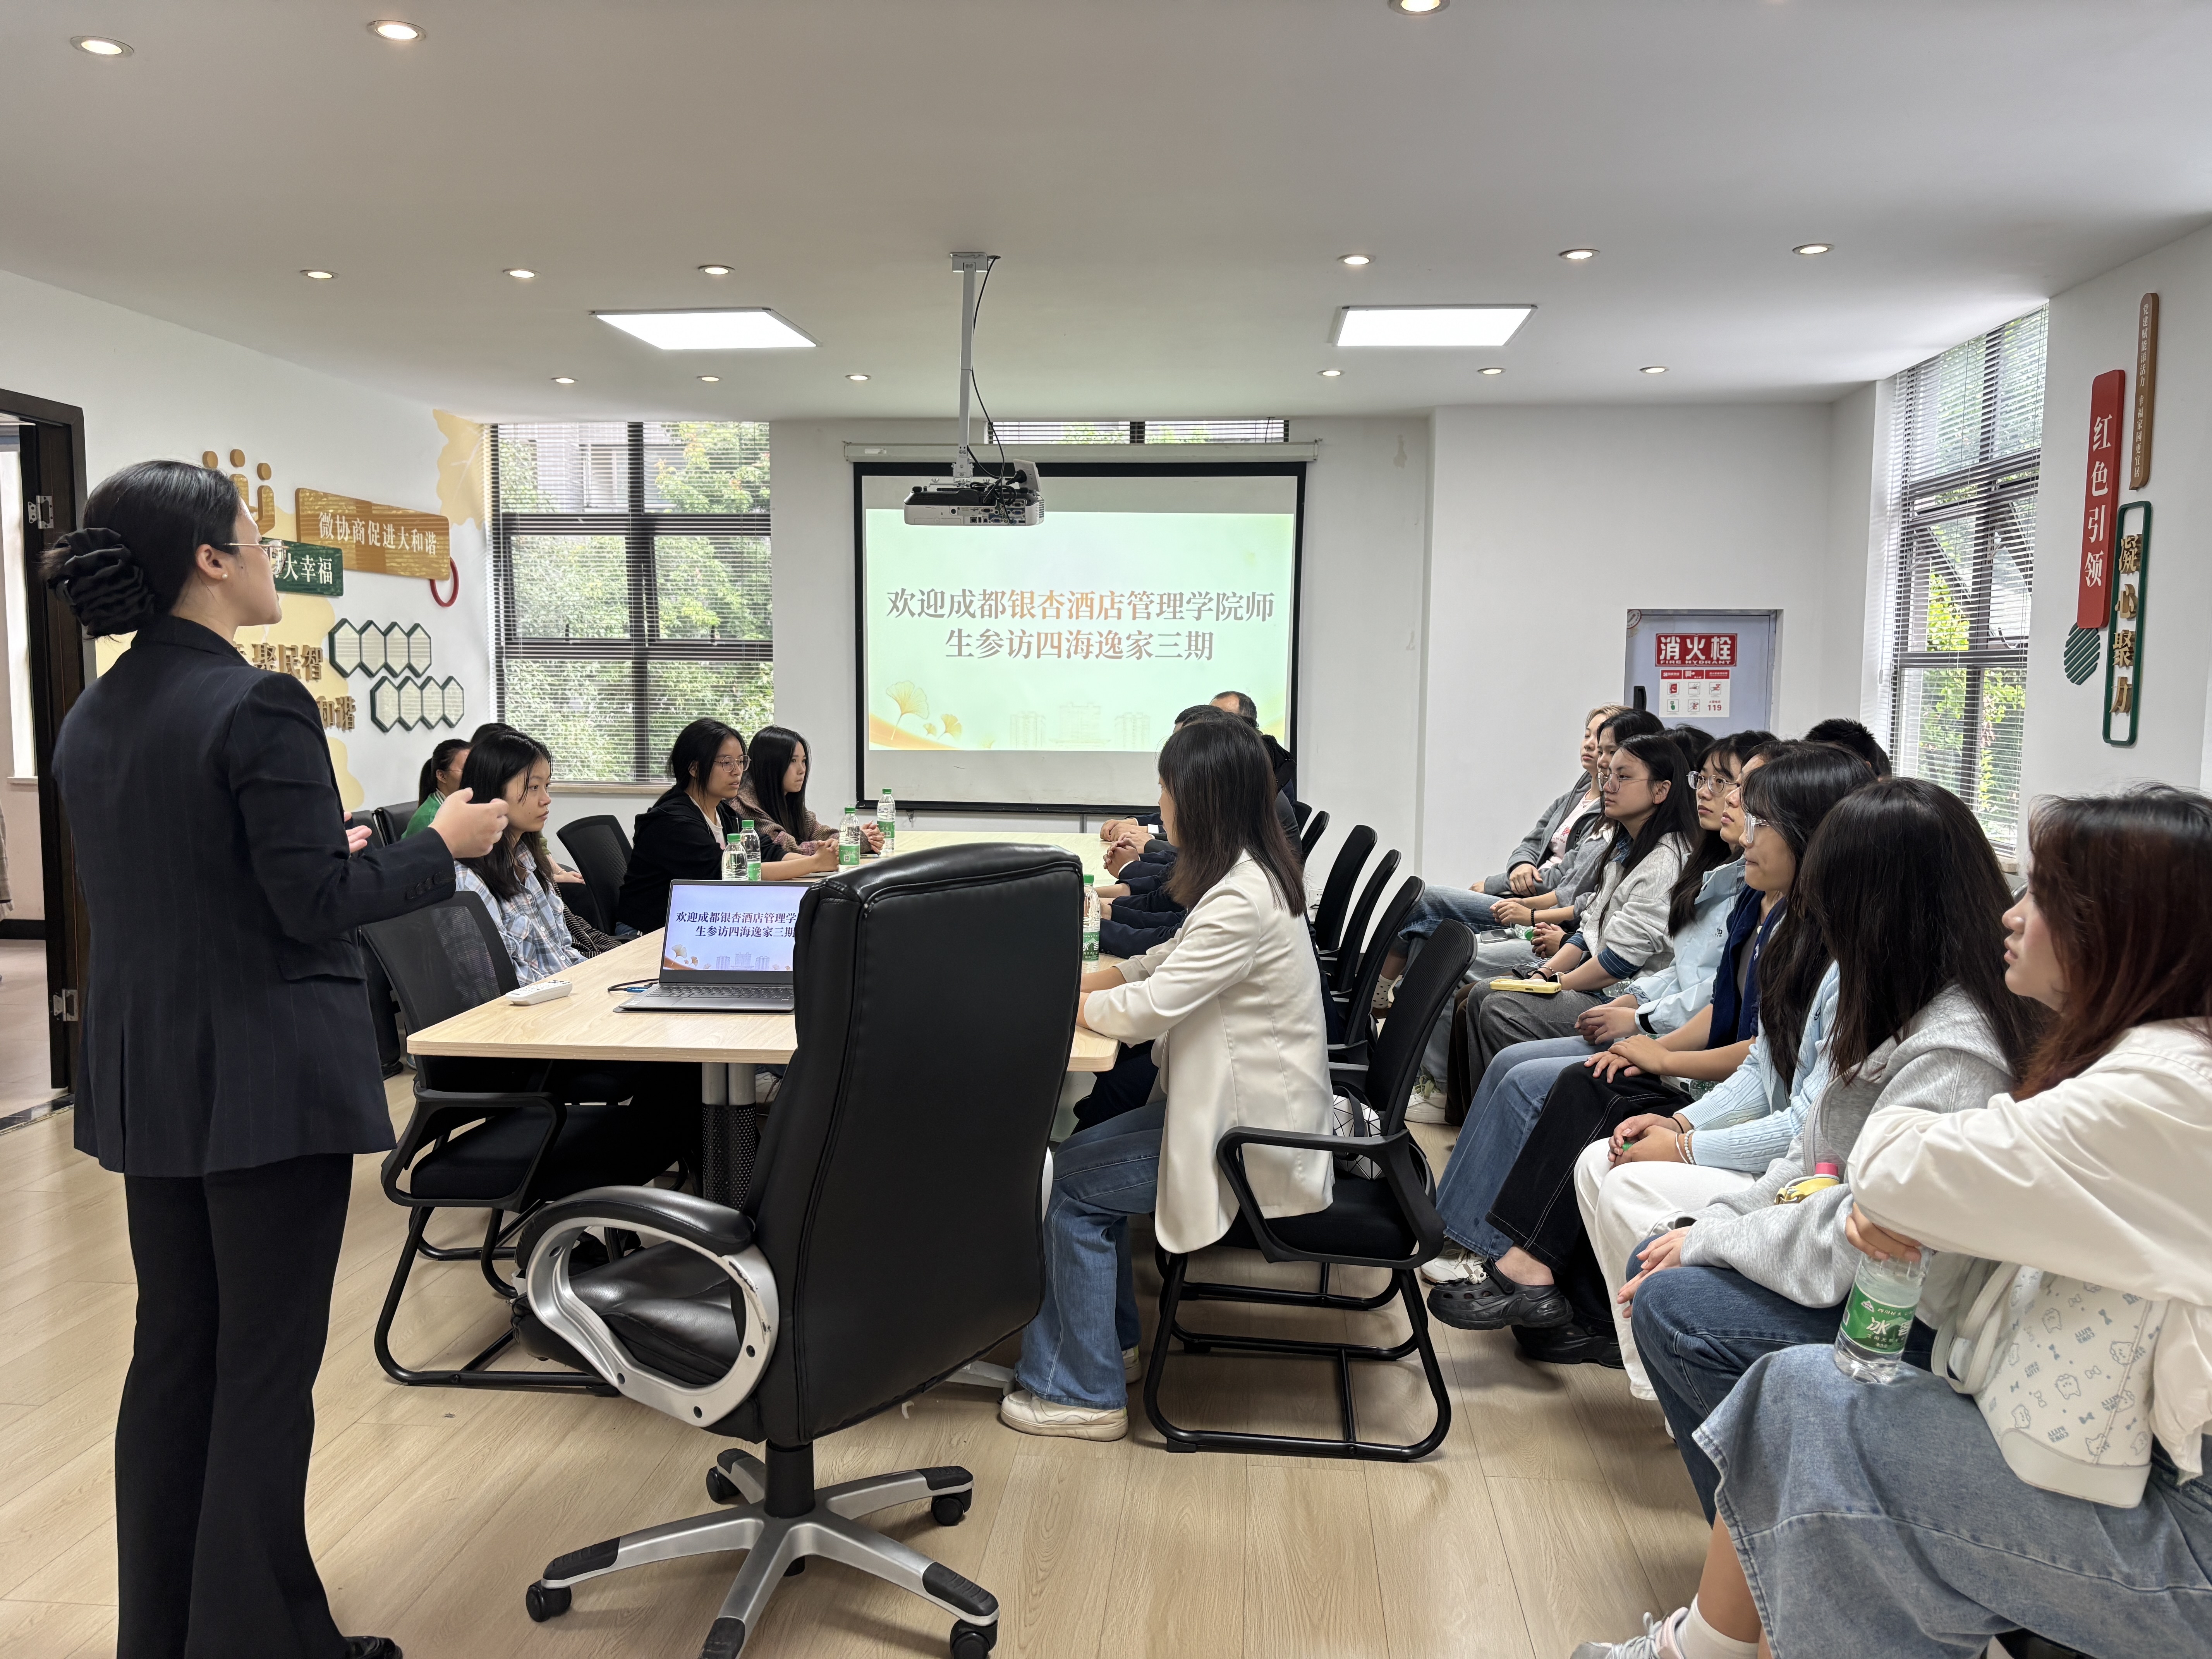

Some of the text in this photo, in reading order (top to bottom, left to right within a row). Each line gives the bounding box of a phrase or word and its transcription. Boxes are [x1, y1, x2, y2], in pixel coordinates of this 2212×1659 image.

[2134, 395, 2144, 478] 幸福家园更宜居
[2085, 414, 2112, 588] 红色引领
[318, 511, 437, 555] 微协商促进大和谐
[271, 548, 333, 584] 大幸福
[886, 587, 1275, 622] 欢迎成都银杏酒店管理学院师
[2109, 534, 2140, 713] 凝心聚力
[233, 641, 323, 682] 聚民智
[945, 627, 1214, 661] 生参访四海逸家三期
[1660, 636, 1731, 660] 消火栓
[675, 911, 798, 924] 欢迎成都银杏酒店管理学
[695, 926, 795, 938] 生参访四海逸家三期
